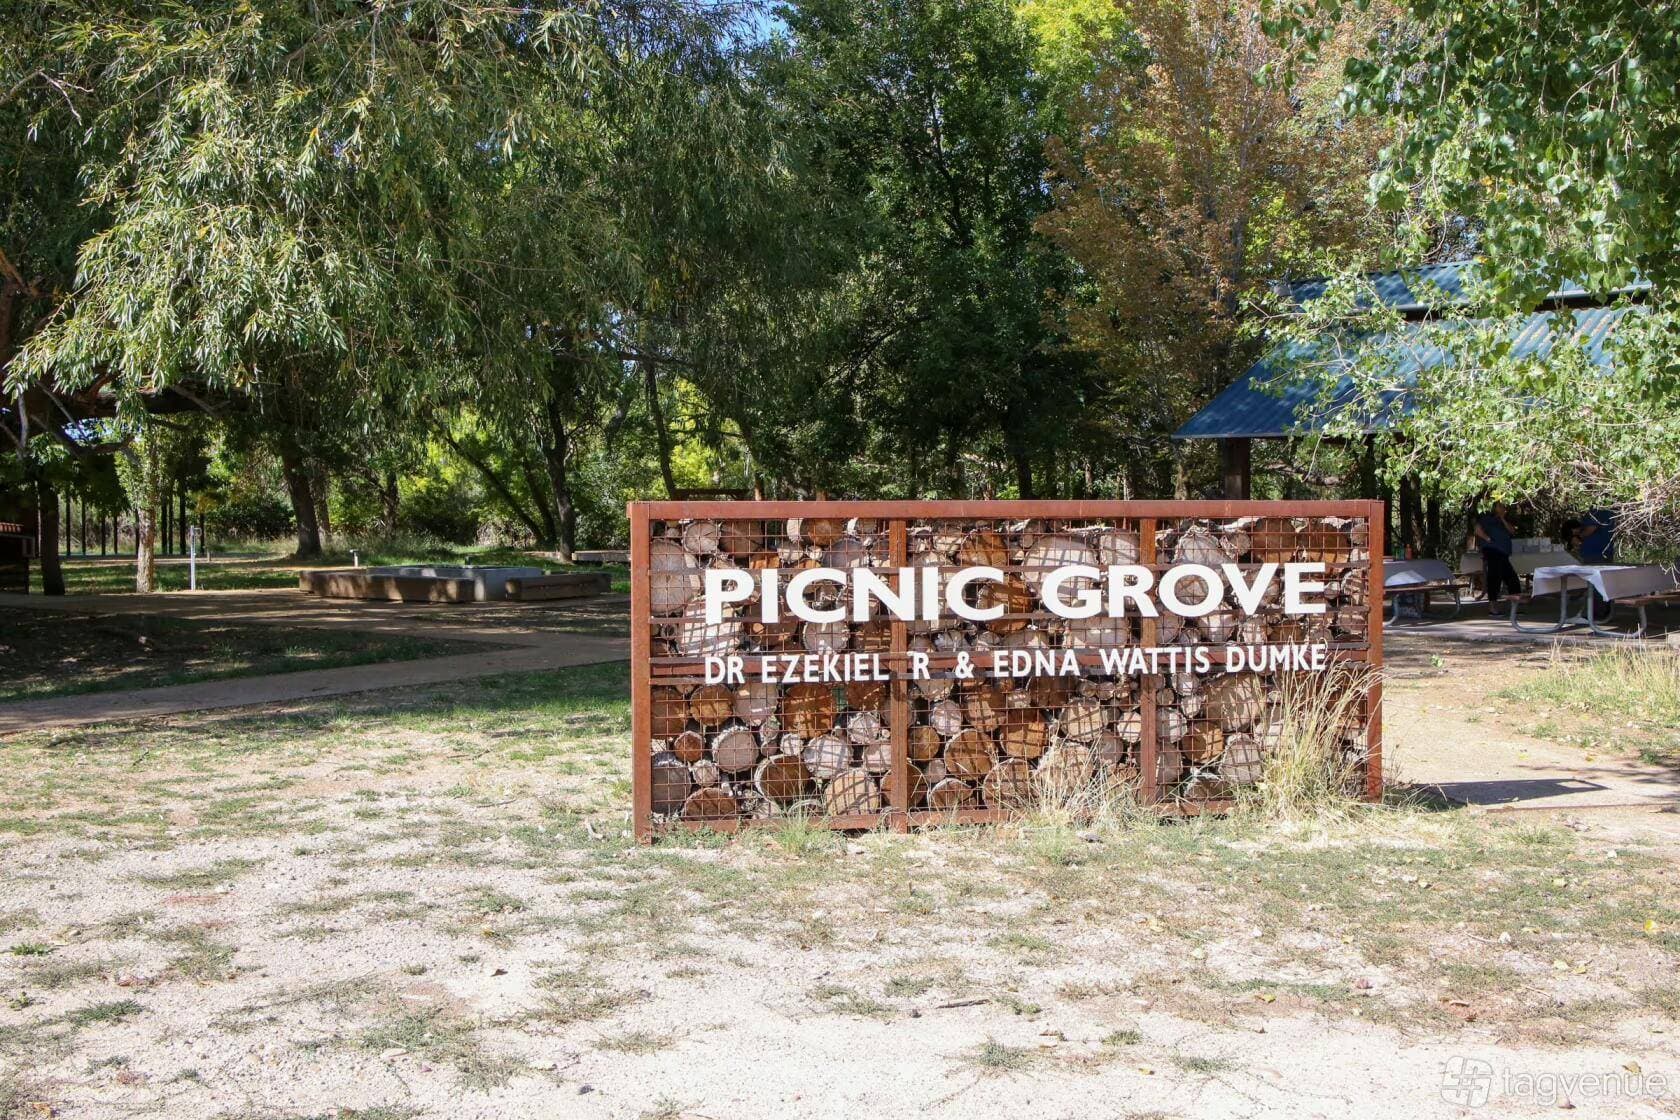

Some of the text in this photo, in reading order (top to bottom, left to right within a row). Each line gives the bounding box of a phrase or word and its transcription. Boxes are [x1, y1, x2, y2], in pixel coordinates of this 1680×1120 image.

[705, 562, 1327, 625] PICNIC GROVE
[705, 643, 1327, 685] DR EZEKIEL R & EDNA WATTIS DUMKE
